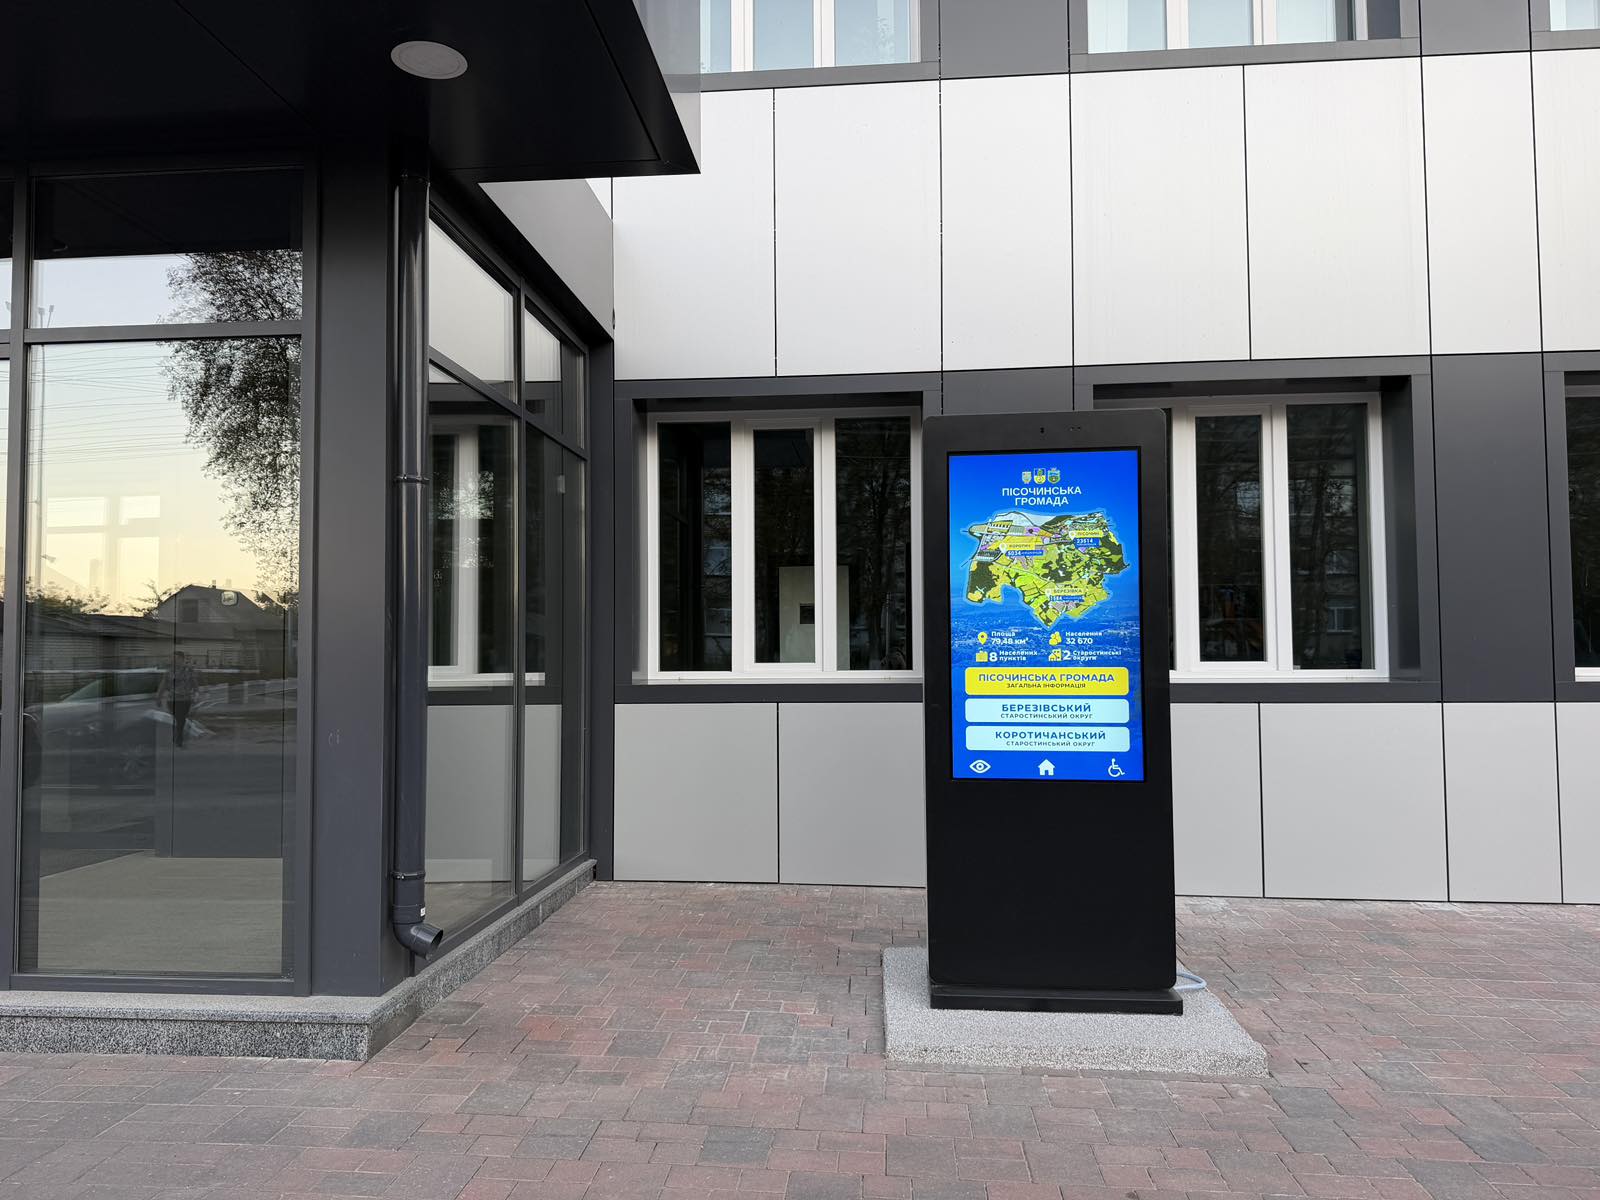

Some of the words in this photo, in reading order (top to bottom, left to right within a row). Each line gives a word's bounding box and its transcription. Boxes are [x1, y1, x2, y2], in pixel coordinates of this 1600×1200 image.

[1002, 486, 1081, 496] ПІСОЧИНСЬКА
[1015, 497, 1068, 506] ГРОМАДА
[989, 652, 997, 661] 8
[1063, 650, 1071, 660] 2
[979, 673, 1056, 681] ПІСОЧИНСЬКА
[1060, 674, 1114, 682] ГРОМАДА
[1002, 702, 1091, 712] БЕРЕЗІВСЬКИЙ
[995, 731, 1105, 739] КОРОТИЧАНСЬКИЙ
